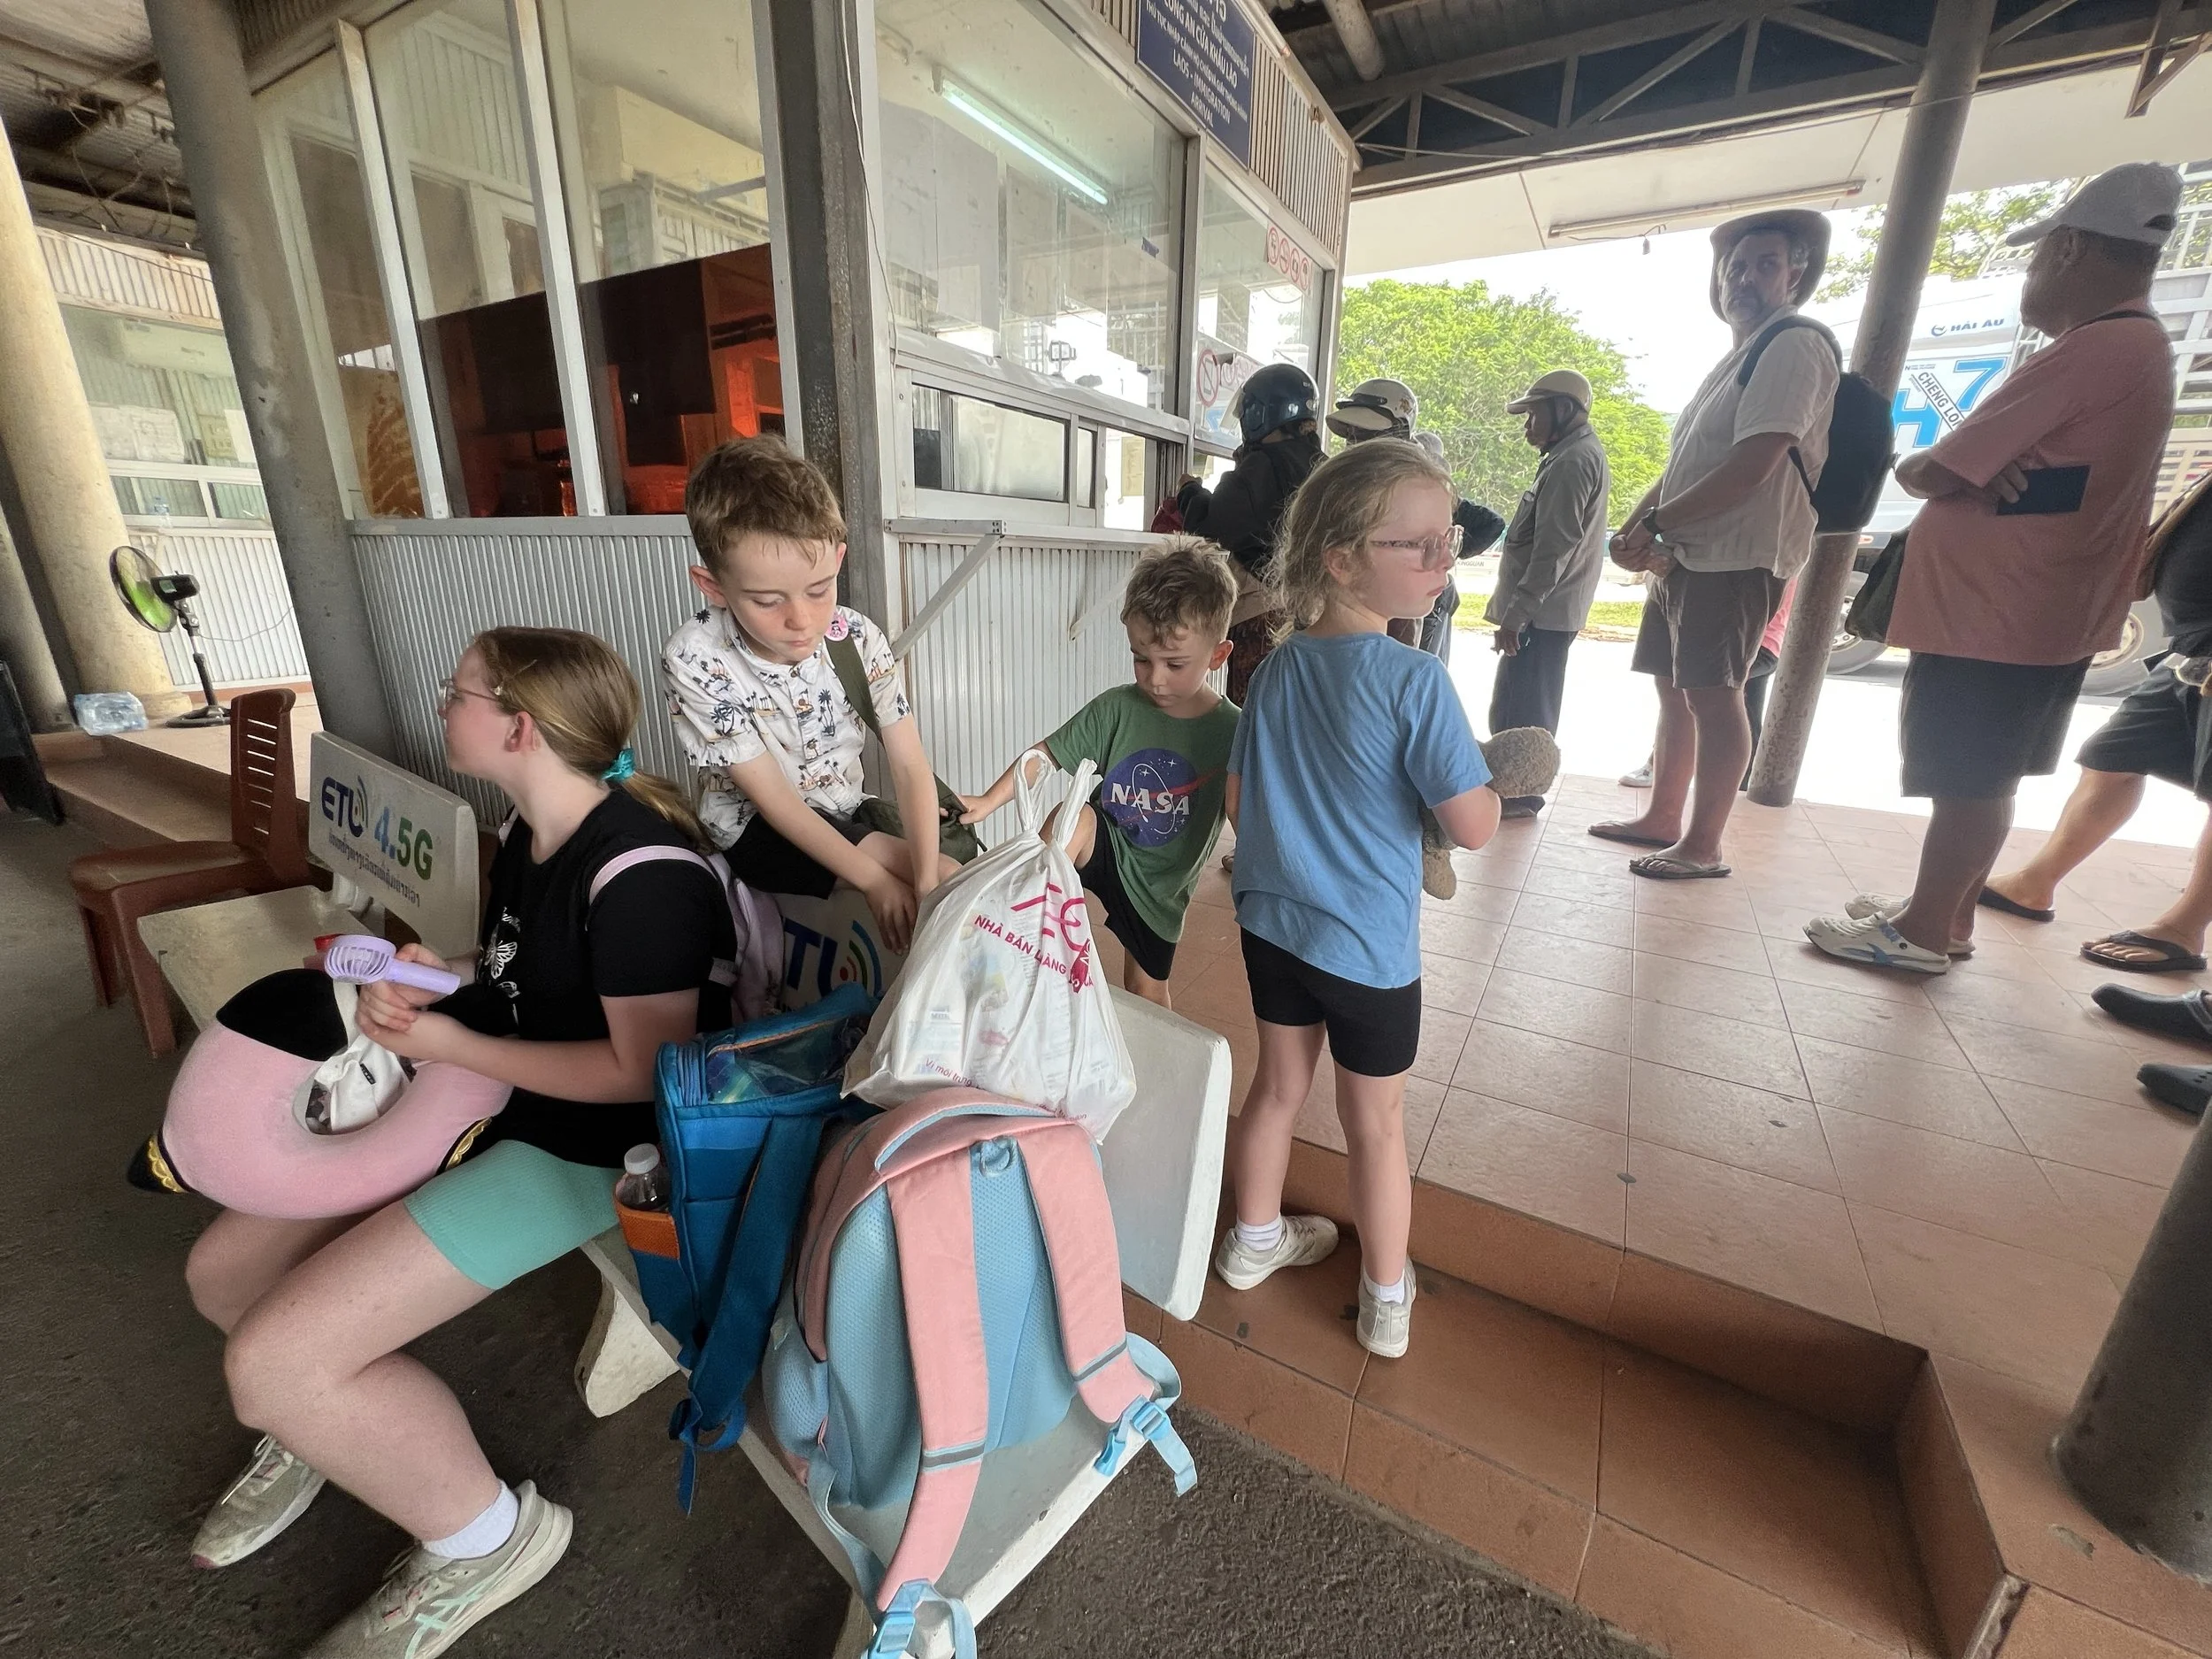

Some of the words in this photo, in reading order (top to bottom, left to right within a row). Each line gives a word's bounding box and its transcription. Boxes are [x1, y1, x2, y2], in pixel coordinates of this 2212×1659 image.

[1186, 12, 1194, 38] AN
[1173, 49, 1189, 78] LAOS
[1194, 72, 1230, 124] IMMIGRATION
[1191, 92, 1213, 127] ARRIVAL
[1918, 372, 1949, 408] CHENG
[1110, 782, 1190, 816] NASA
[322, 776, 365, 837] ETL
[374, 806, 434, 880] 4.5G
[974, 914, 1003, 937] NHÀ
[1005, 932, 1033, 955] BÁN
[780, 914, 838, 997] TL
